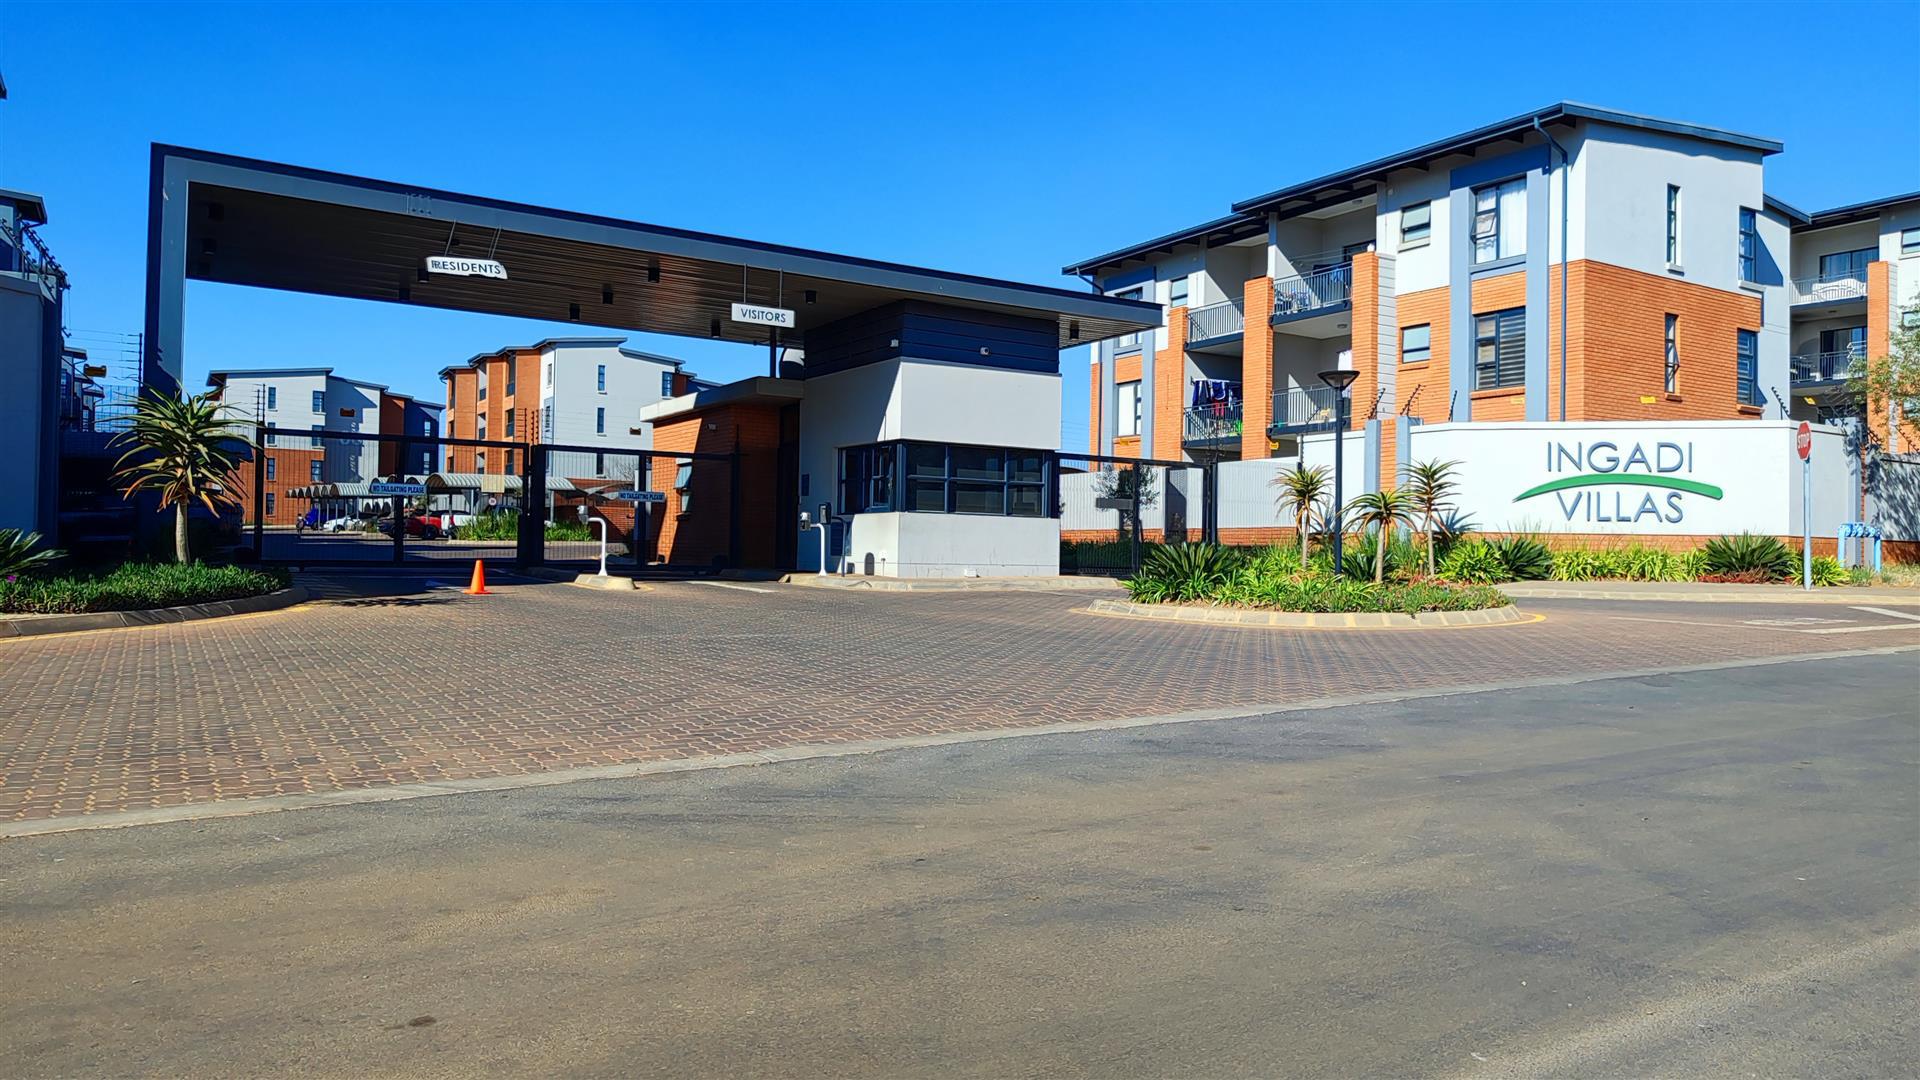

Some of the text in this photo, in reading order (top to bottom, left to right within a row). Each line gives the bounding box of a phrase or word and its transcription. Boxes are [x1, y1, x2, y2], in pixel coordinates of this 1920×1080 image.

[740, 308, 786, 323] VISITORS
[1798, 432, 1810, 449] STOP
[1547, 441, 1693, 473] INGADI
[381, 485, 407, 493] TAILGATING
[1556, 491, 1684, 524] VILLAS
